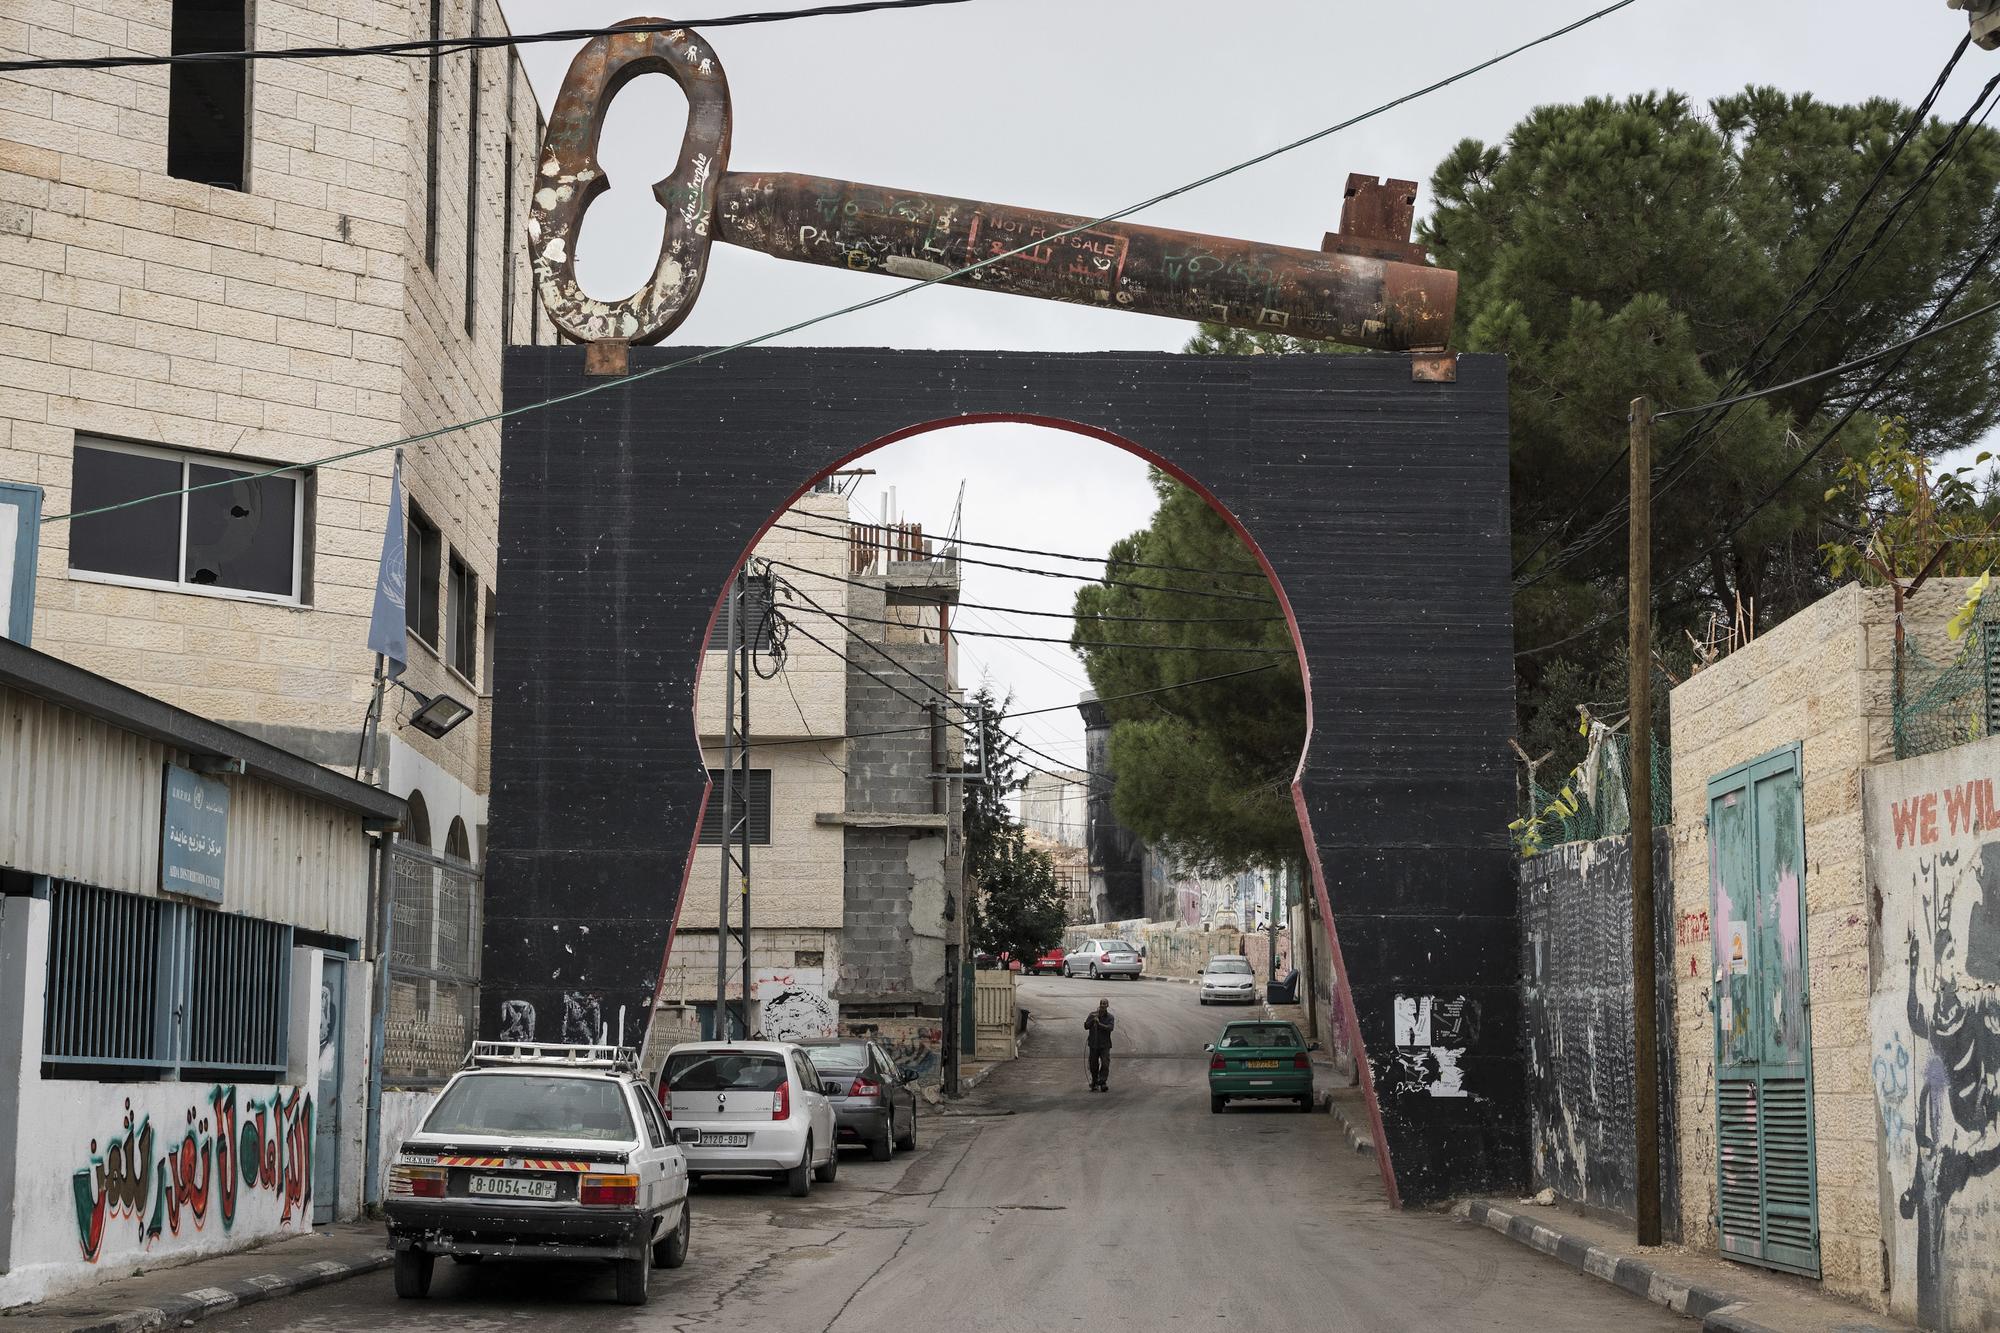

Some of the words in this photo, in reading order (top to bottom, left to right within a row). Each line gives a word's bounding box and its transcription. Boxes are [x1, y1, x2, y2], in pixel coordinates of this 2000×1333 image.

[990, 217, 1023, 234] NOT
[1070, 236, 1116, 257] SALE
[170, 825, 188, 847] عايدة
[1891, 792, 1939, 850] WE
[188, 833, 206, 852] توزيع
[206, 837, 222, 857] مركز
[211, 1085, 238, 1228] لا
